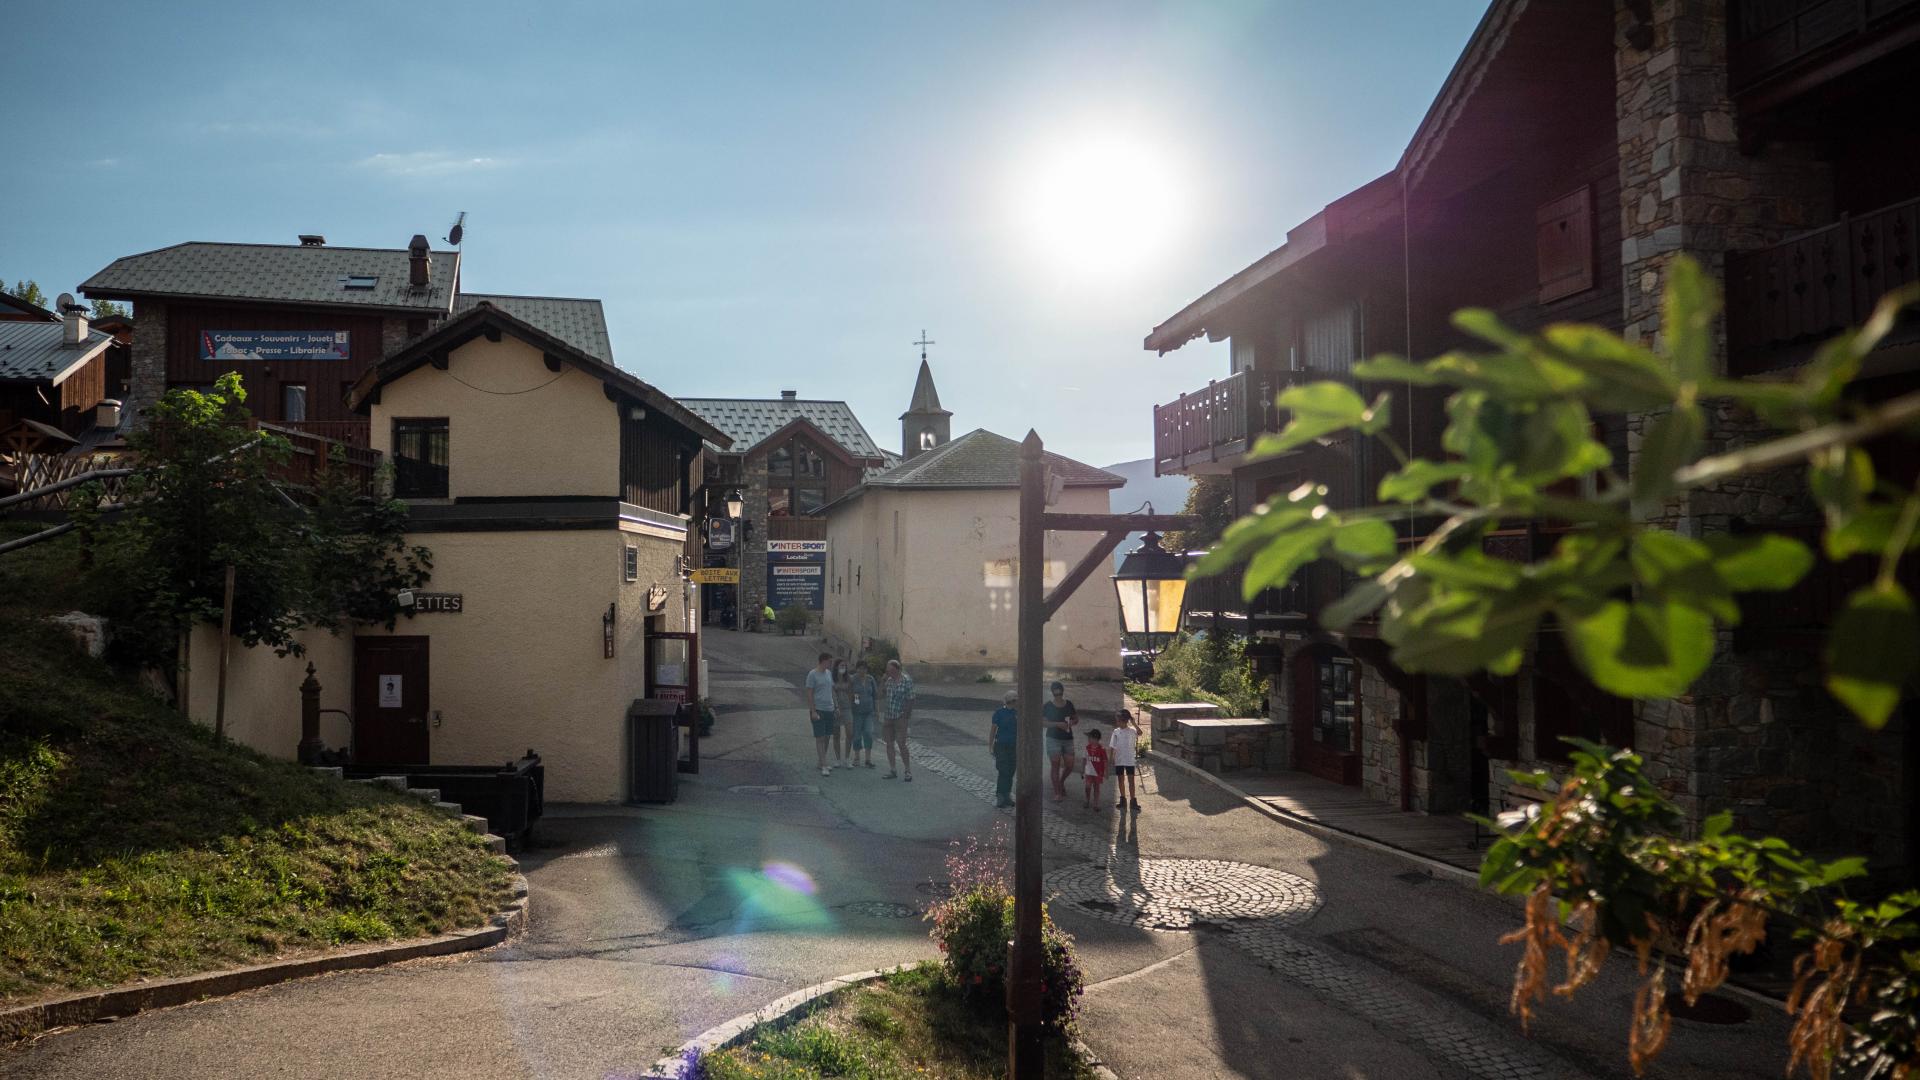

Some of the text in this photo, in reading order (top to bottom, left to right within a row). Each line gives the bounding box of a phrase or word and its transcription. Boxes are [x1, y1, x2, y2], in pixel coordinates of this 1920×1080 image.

[214, 334, 252, 342] Cadeaux
[260, 334, 300, 342] Souvenirs
[308, 334, 334, 343] Jouets
[255, 346, 282, 354] Presse
[290, 346, 327, 354] Librairie
[778, 542, 825, 550] INTERSPORT
[416, 596, 461, 610] ETTES
